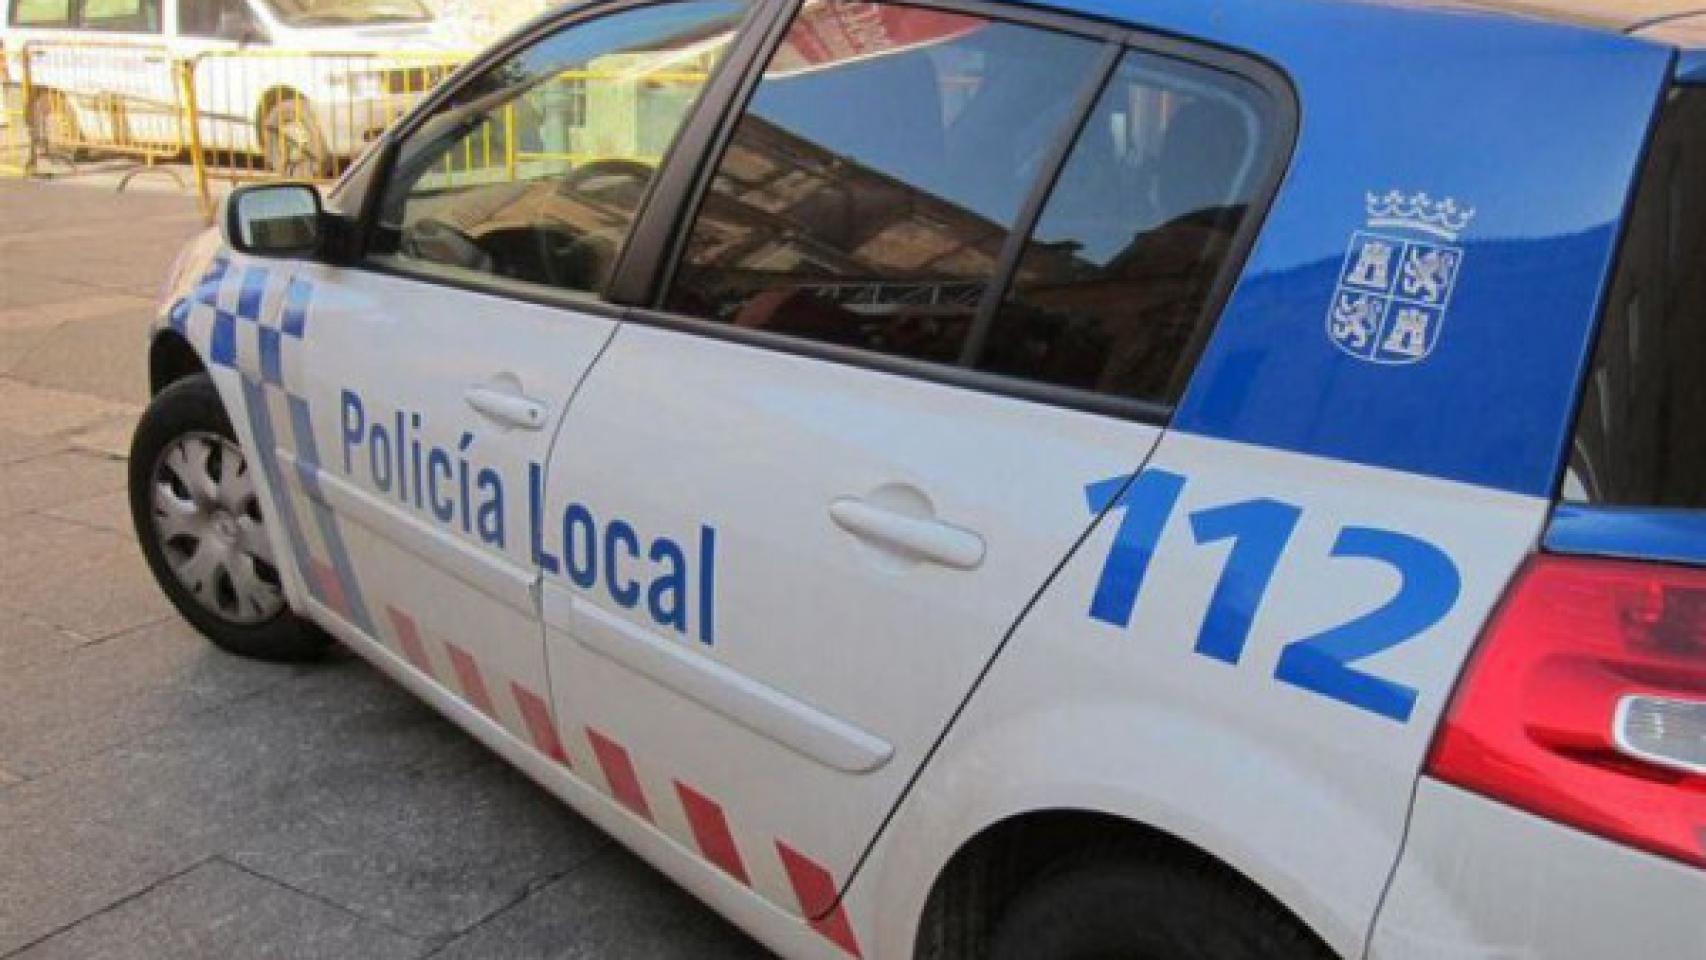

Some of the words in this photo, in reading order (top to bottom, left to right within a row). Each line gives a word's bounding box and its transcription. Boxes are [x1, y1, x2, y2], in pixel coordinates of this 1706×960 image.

[341, 388, 504, 549] Policía
[529, 462, 715, 646] Local
[1084, 468, 1462, 723] 112
